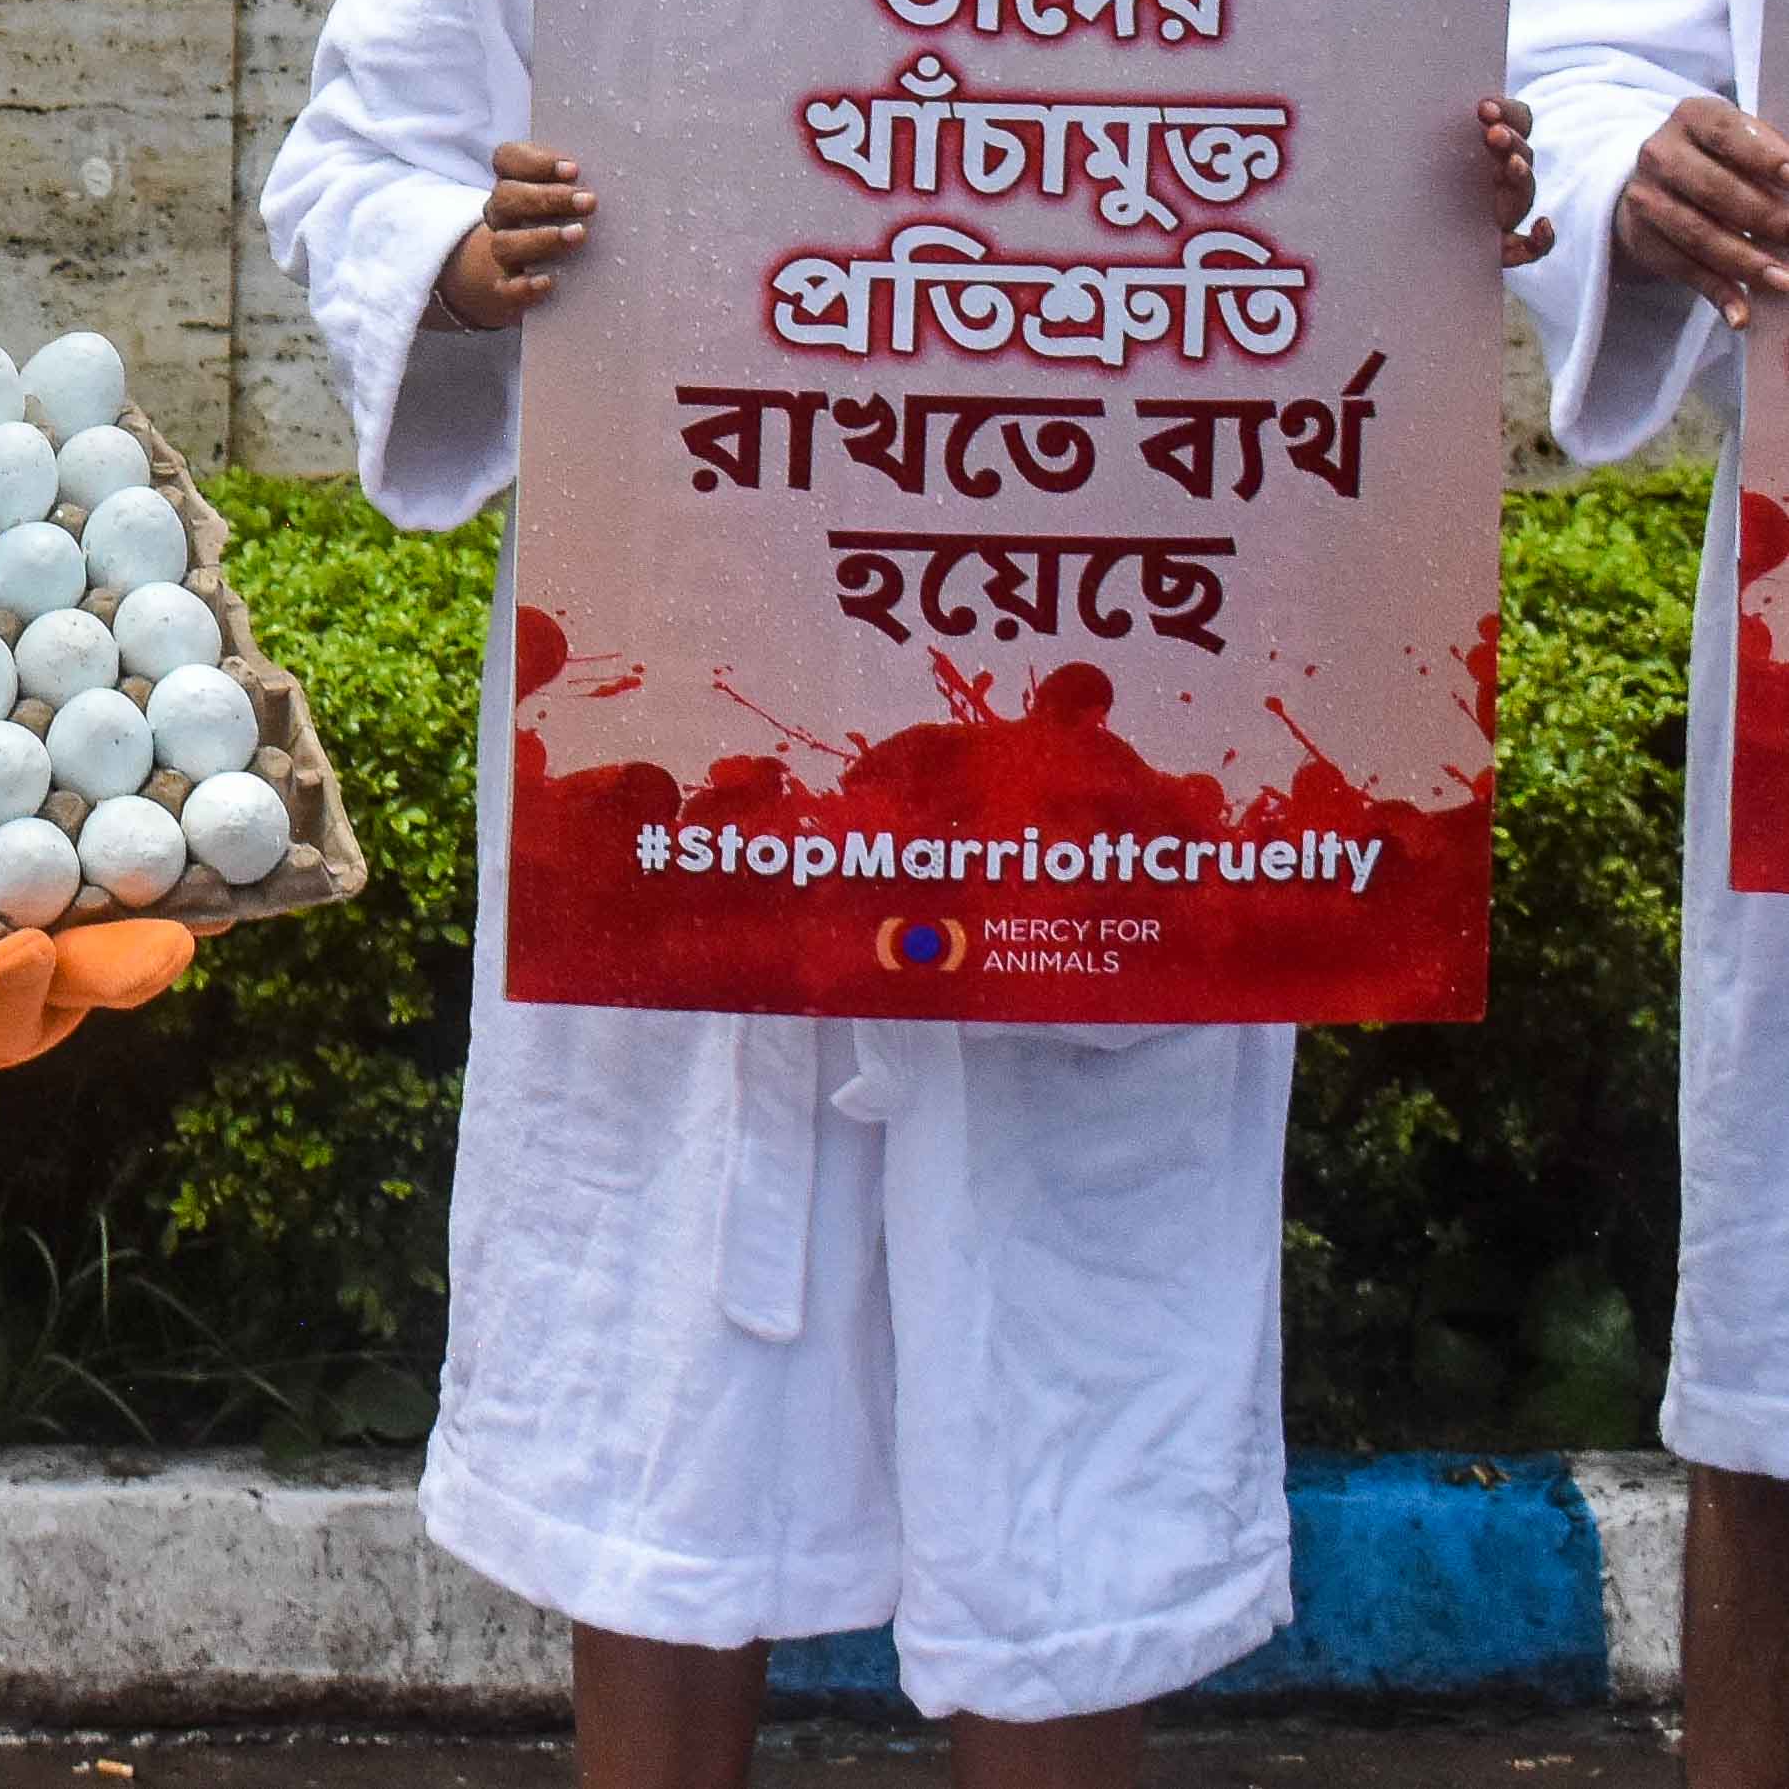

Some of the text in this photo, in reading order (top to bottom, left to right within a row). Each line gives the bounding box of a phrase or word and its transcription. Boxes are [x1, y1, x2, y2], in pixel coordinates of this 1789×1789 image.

[805, 54, 1287, 232] খাঁচামুক্ত
[773, 224, 1306, 367] প্রতিশ্রুতি
[676, 351, 1387, 503] রাখতে ব্যর্থ
[827, 530, 1236, 655] হয়েছে
[636, 823, 1382, 893] #StopMarriottCruelty
[983, 918, 1160, 943] MERCY FOR
[983, 949, 1120, 974] ANIMALS
